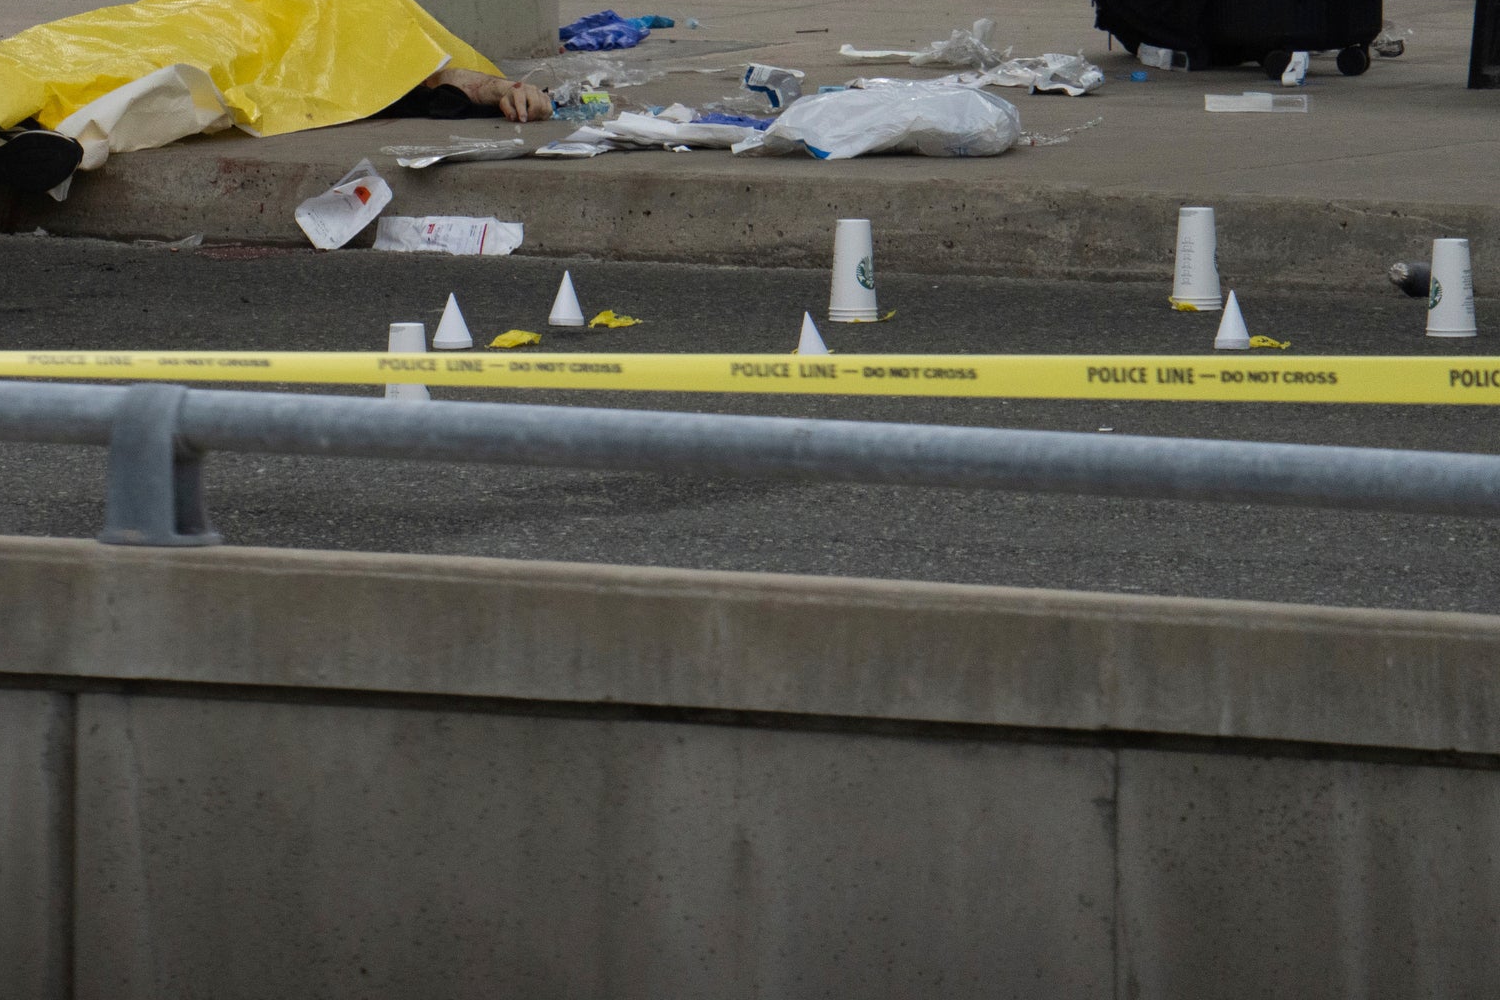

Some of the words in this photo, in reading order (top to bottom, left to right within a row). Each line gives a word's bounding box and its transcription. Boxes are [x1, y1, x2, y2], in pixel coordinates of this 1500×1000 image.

[27, 355, 87, 366] POLICE
[95, 356, 133, 367] LINE
[377, 358, 437, 371] POLICE
[446, 359, 483, 372] LINE
[509, 362, 531, 372] DO
[535, 362, 565, 373] NOT
[569, 363, 623, 374] CROSS
[730, 362, 791, 378] POLICE
[799, 363, 837, 379] LINE
[863, 366, 886, 378] DO
[889, 367, 920, 378] NOT
[923, 368, 978, 380] CROSS
[1087, 367, 1148, 384] POLICE
[1155, 367, 1194, 385] LINE
[1220, 370, 1244, 383] DO
[1247, 370, 1279, 384] NOT
[1282, 371, 1338, 385] CROSS
[1449, 369, 1500, 387] POLIC
